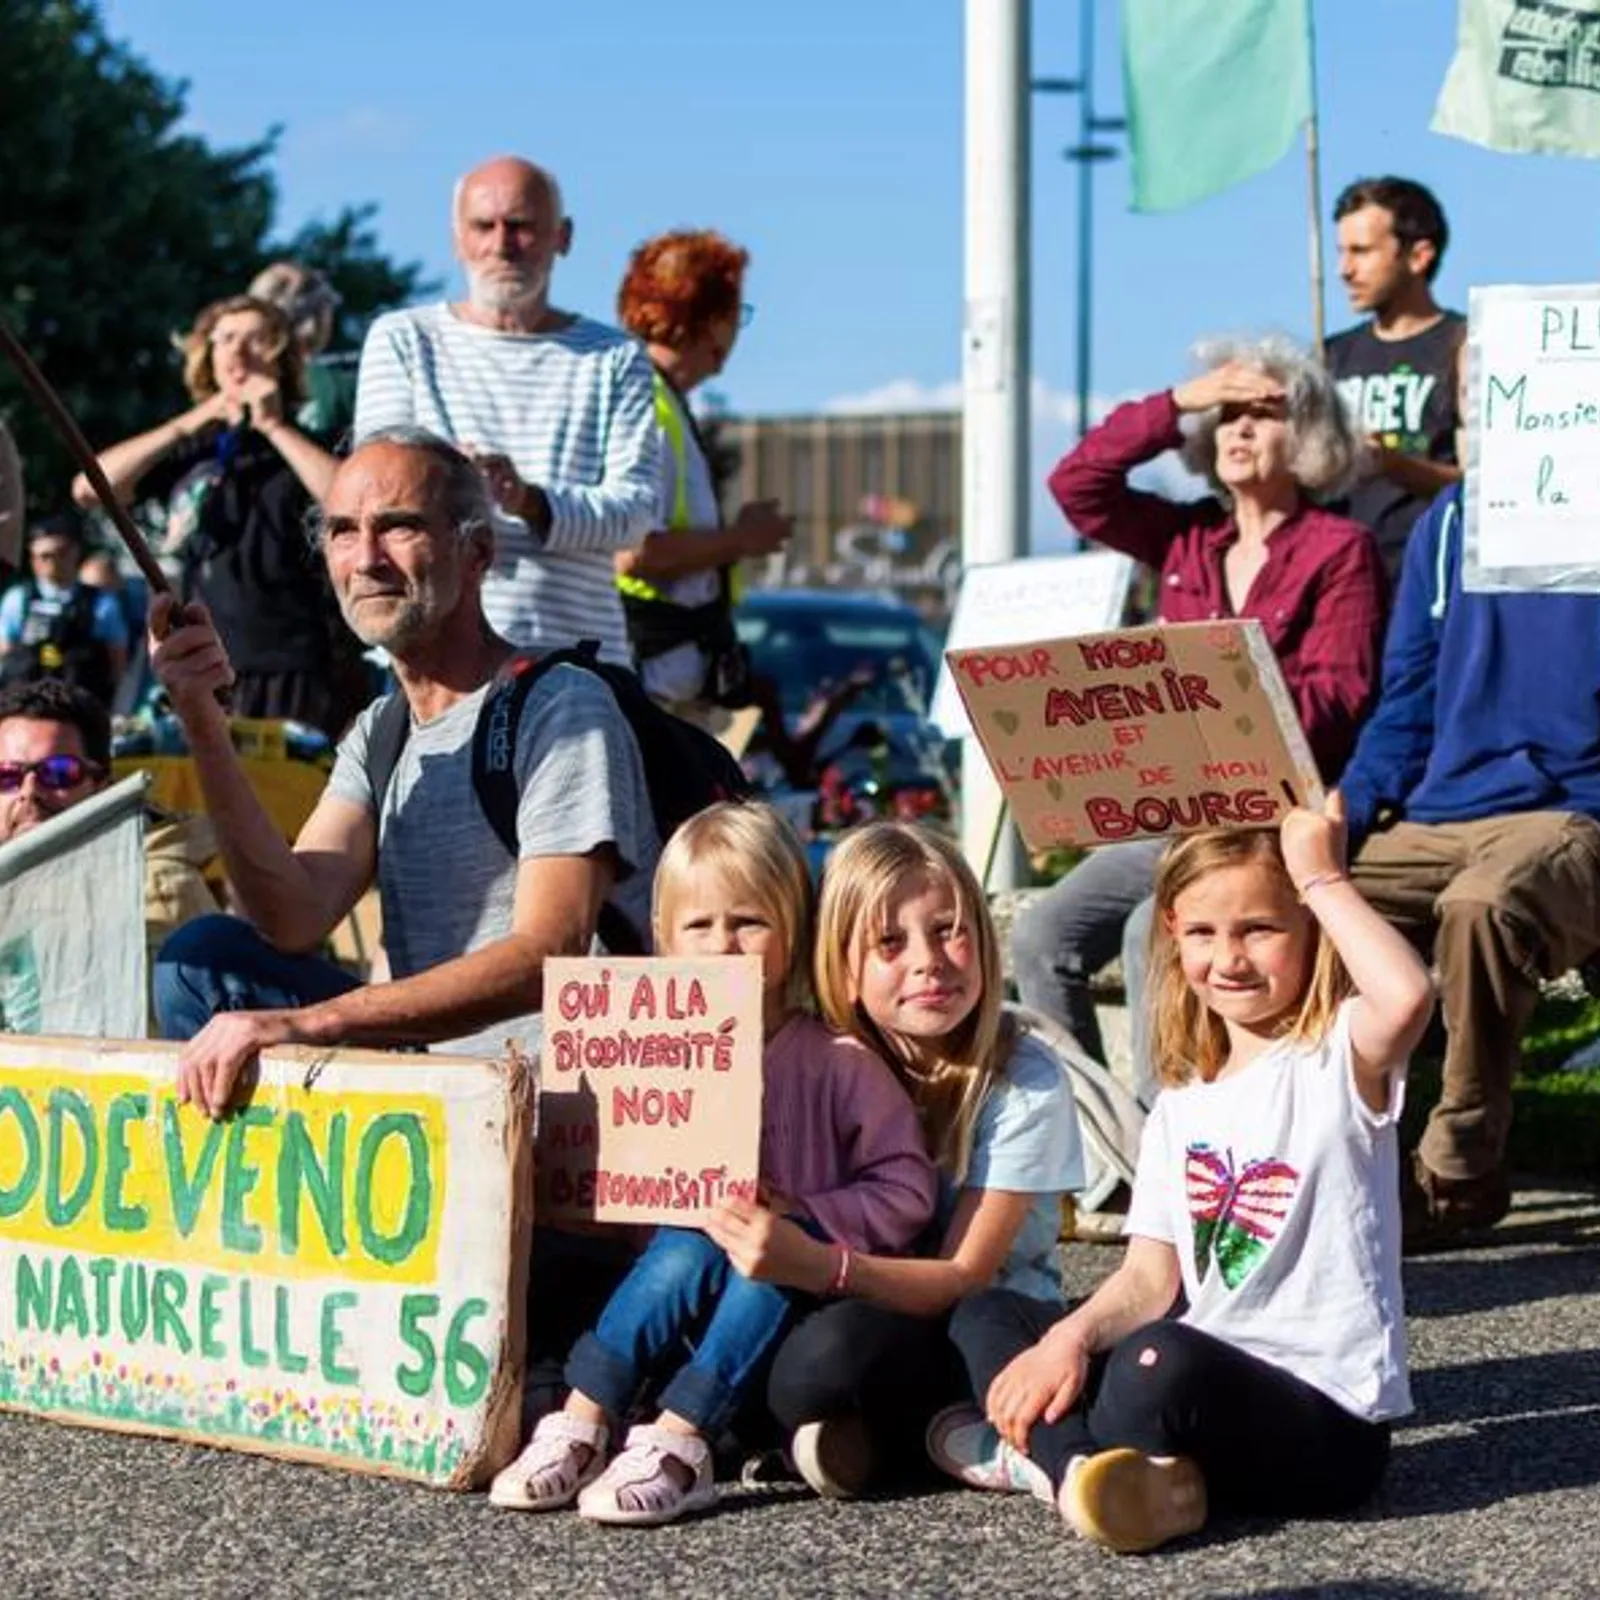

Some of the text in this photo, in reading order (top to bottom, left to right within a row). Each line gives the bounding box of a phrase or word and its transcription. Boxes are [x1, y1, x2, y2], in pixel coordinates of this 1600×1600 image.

[1542, 305, 1600, 352] PL
[1536, 454, 1570, 505] la
[958, 636, 1166, 688] POUR MON
[1111, 722, 1148, 746] ET
[999, 749, 1136, 784] L'AVENIR
[1137, 764, 1178, 788] DE
[628, 974, 658, 1020] A
[666, 976, 708, 1020] LA
[612, 1086, 694, 1128] NON
[15, 1254, 490, 1407] NATURELLE 56
